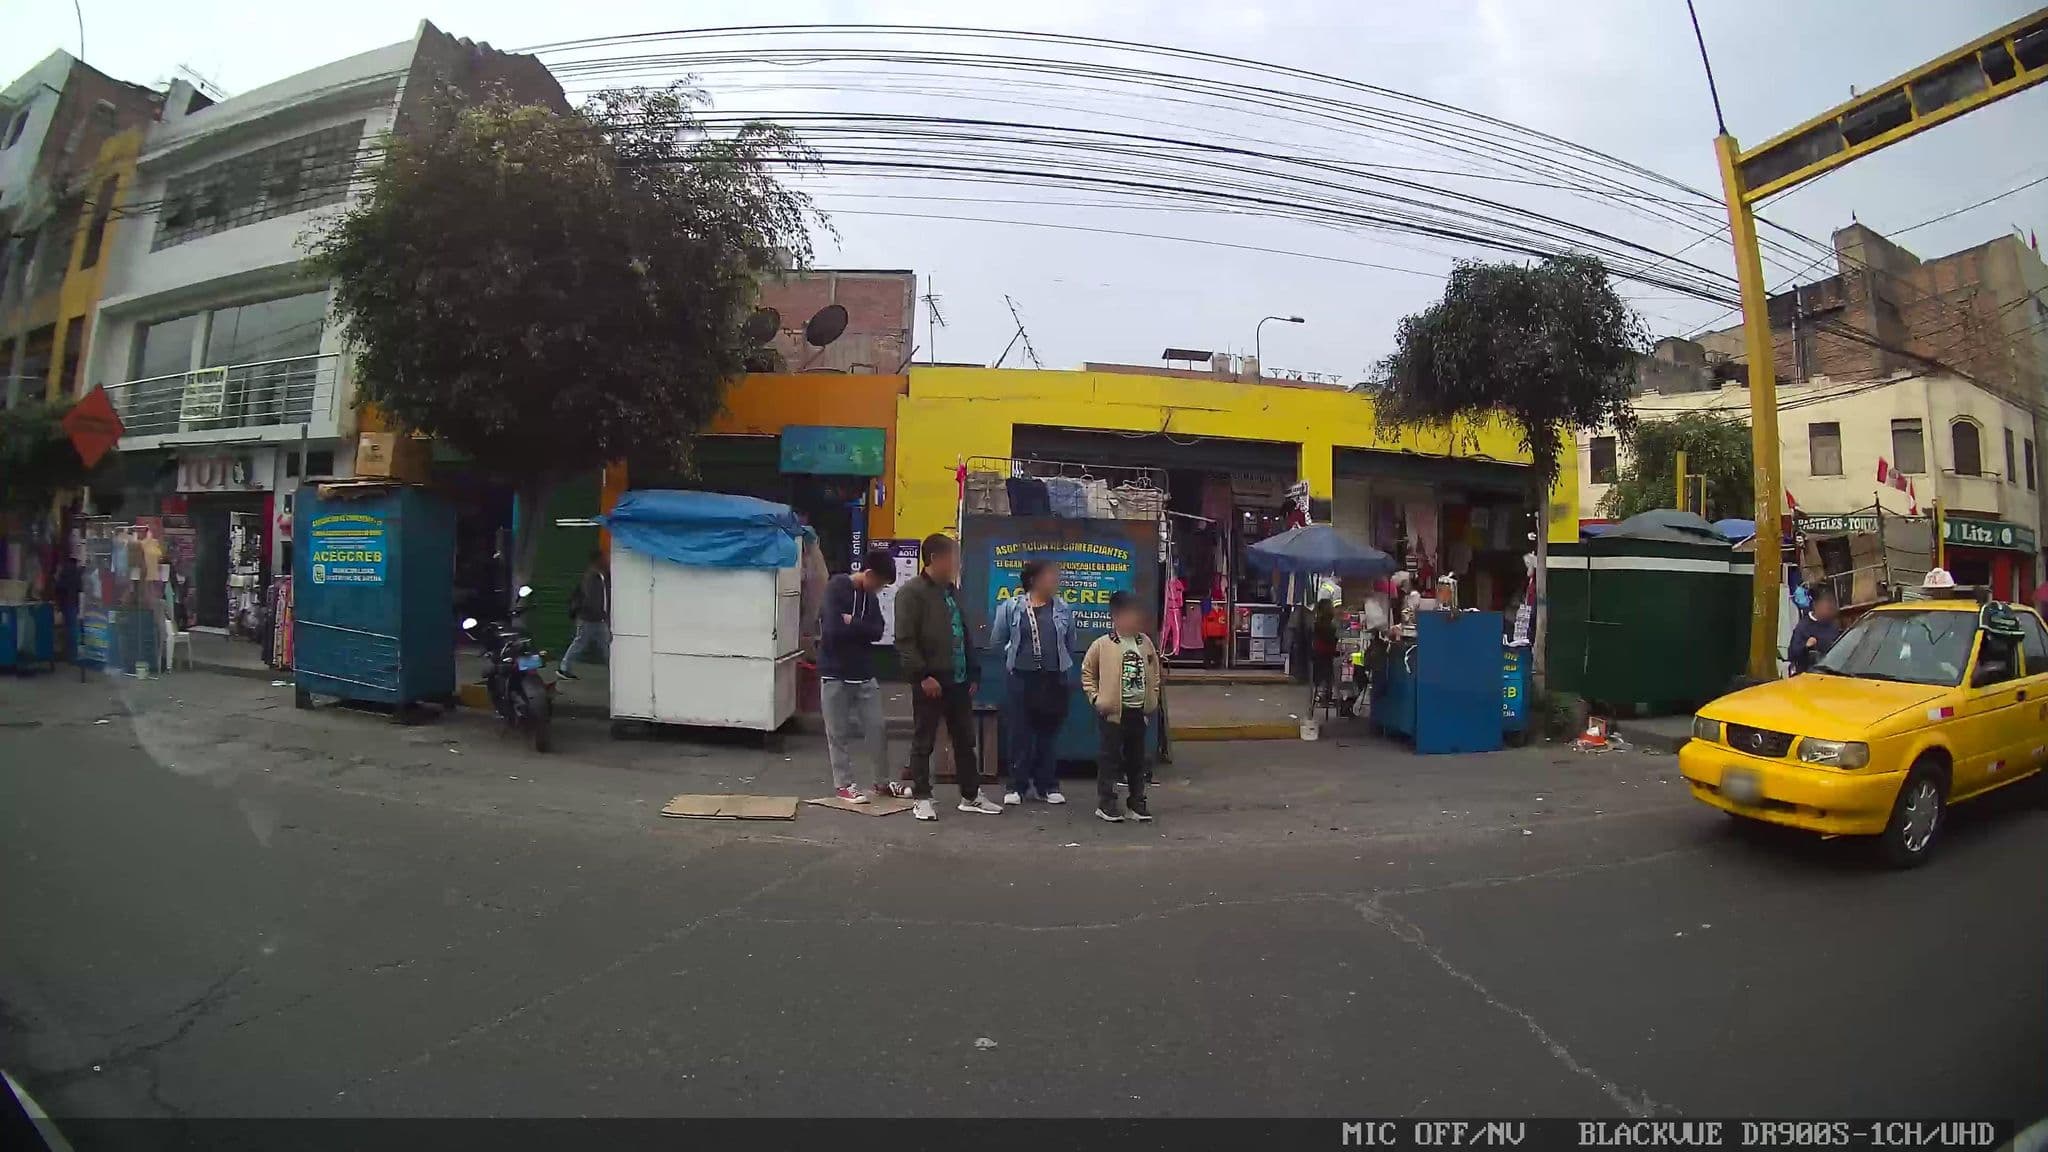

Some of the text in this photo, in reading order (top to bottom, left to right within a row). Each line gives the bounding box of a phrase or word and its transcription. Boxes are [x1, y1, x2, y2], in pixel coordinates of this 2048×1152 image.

[1961, 523, 1993, 542] Litz
[313, 551, 382, 562] ACEGCREB
[898, 548, 918, 557] AQUÍ
[1063, 543, 1129, 560] COMERCIANTES
